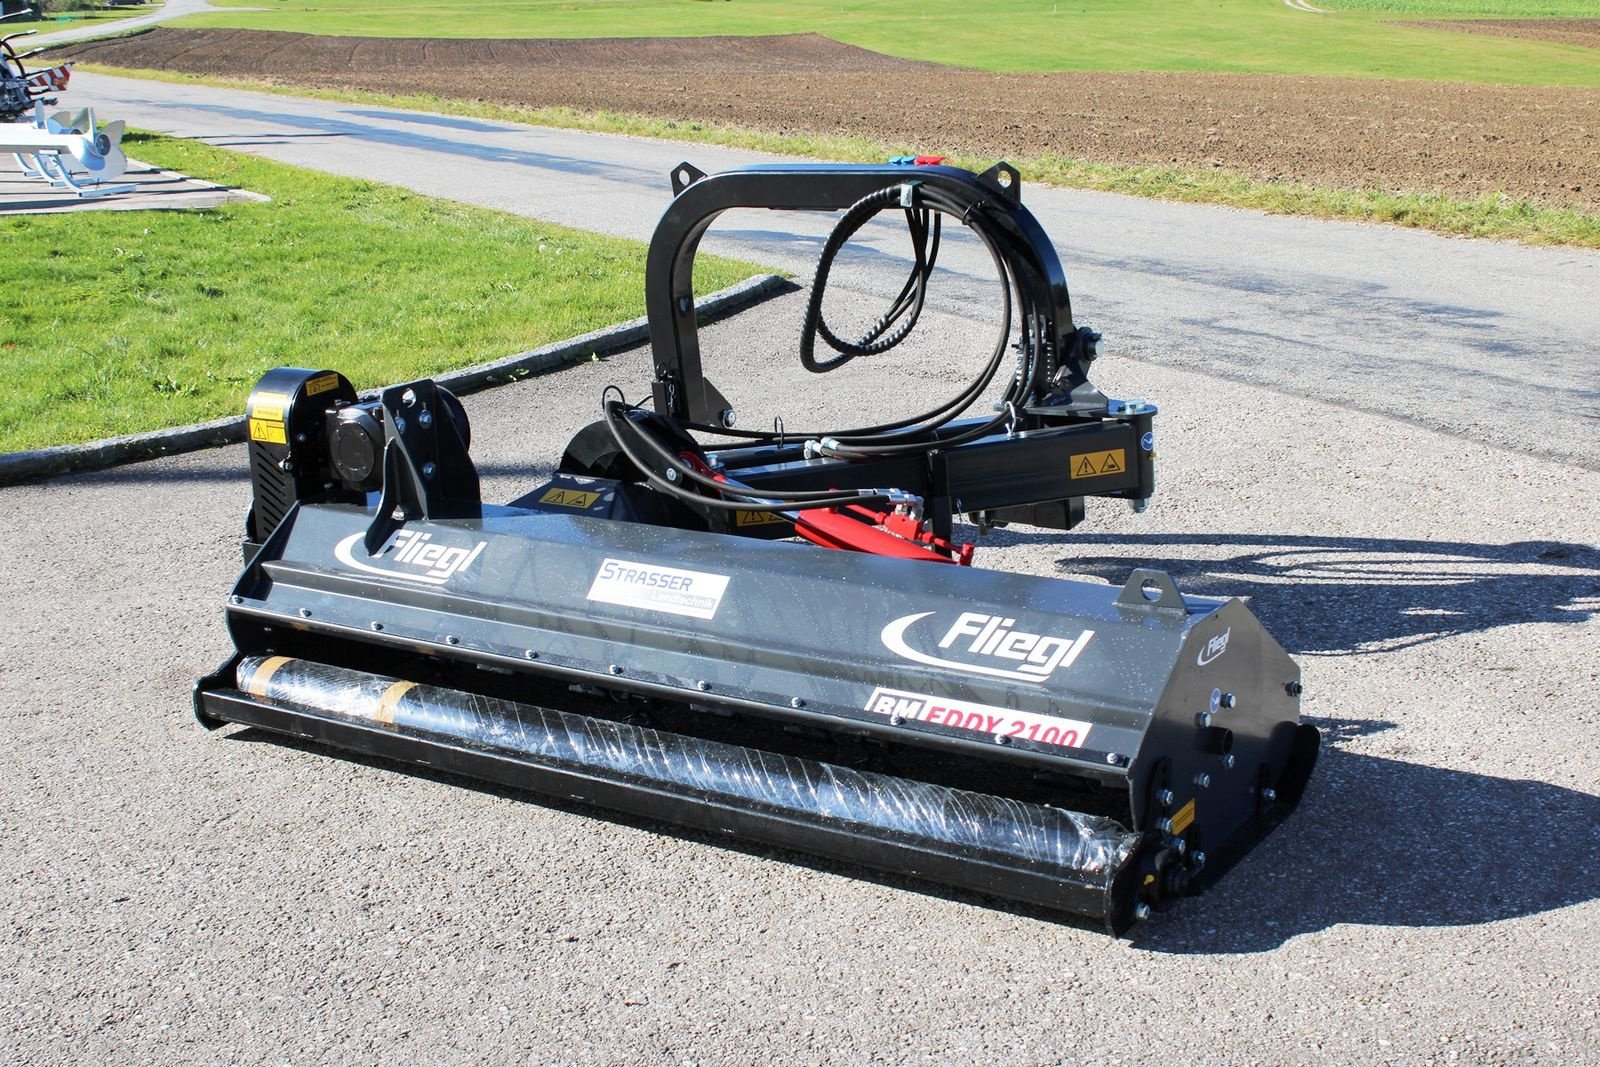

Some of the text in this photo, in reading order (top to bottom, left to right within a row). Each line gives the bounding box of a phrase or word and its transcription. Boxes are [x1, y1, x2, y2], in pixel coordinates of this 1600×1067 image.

[367, 528, 488, 579] Fliegl
[600, 562, 693, 592] STRASSER
[938, 612, 1095, 676] Fliegl
[1207, 626, 1231, 657] Fliegl
[873, 696, 923, 720] BM
